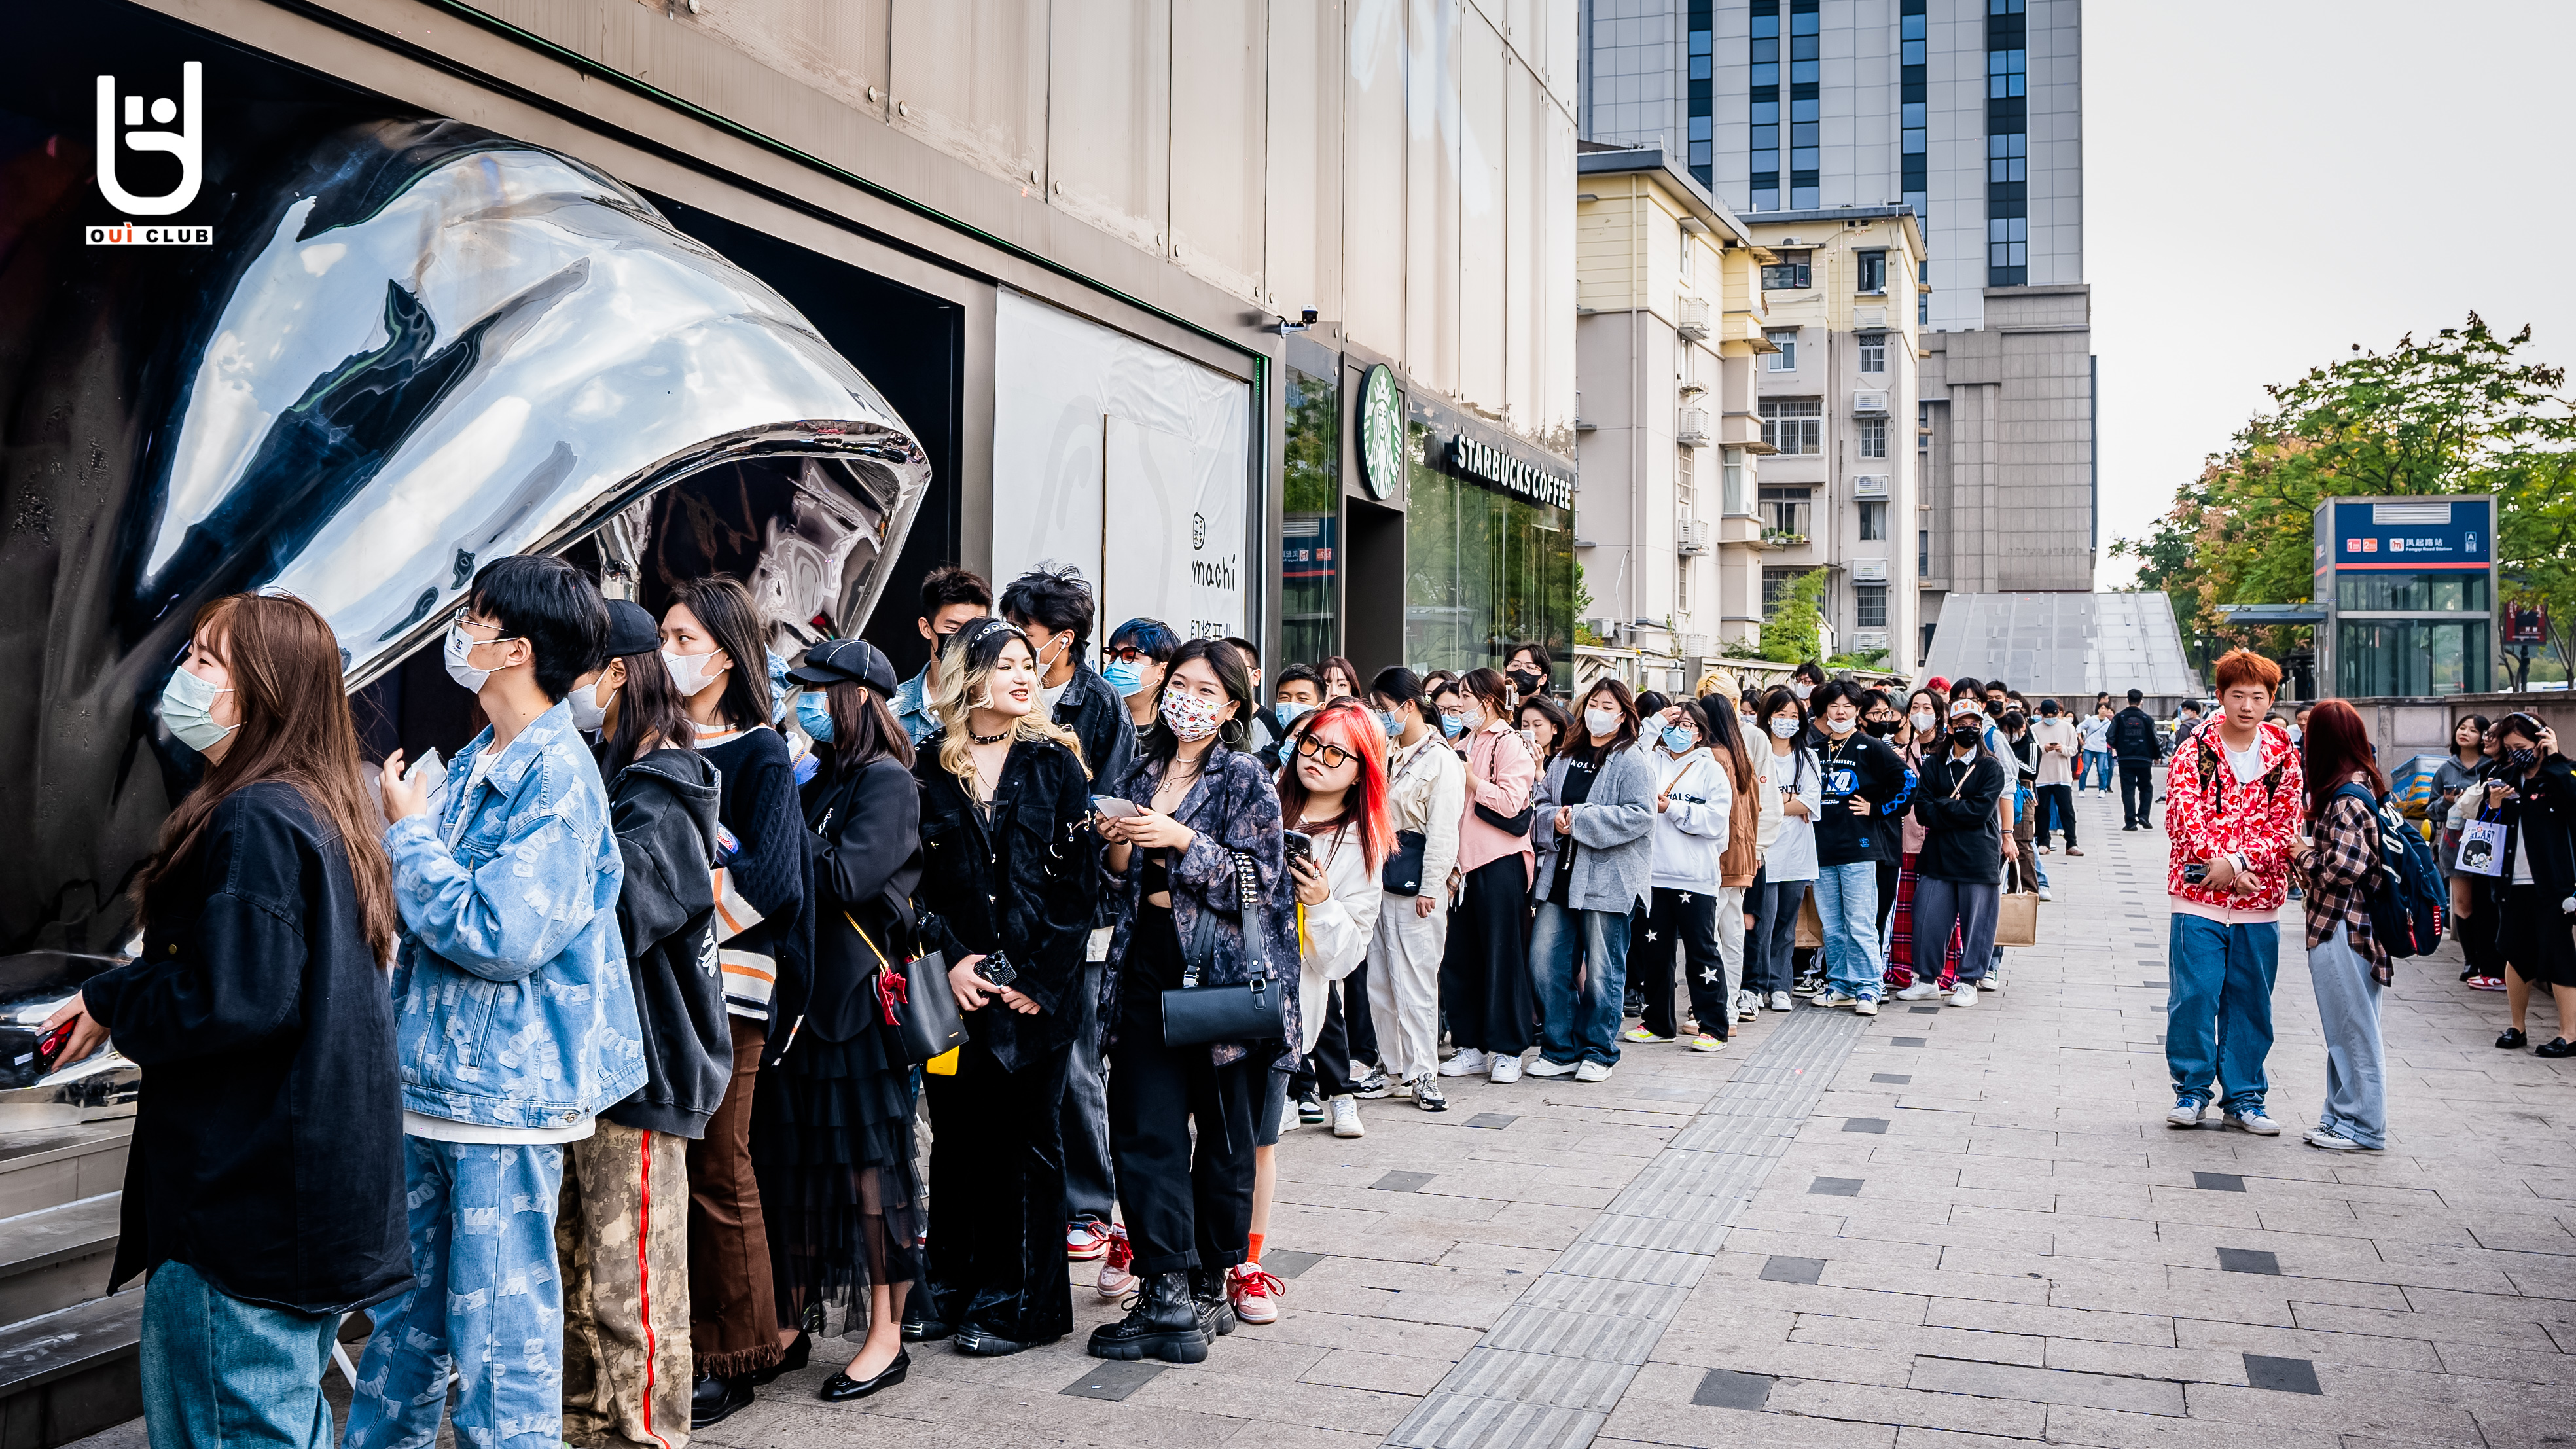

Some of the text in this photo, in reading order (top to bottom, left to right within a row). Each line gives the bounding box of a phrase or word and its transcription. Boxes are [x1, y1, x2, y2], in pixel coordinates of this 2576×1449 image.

[1458, 433, 1571, 510] STARBUCKS COFFEE
[1192, 554, 1236, 592] machi
